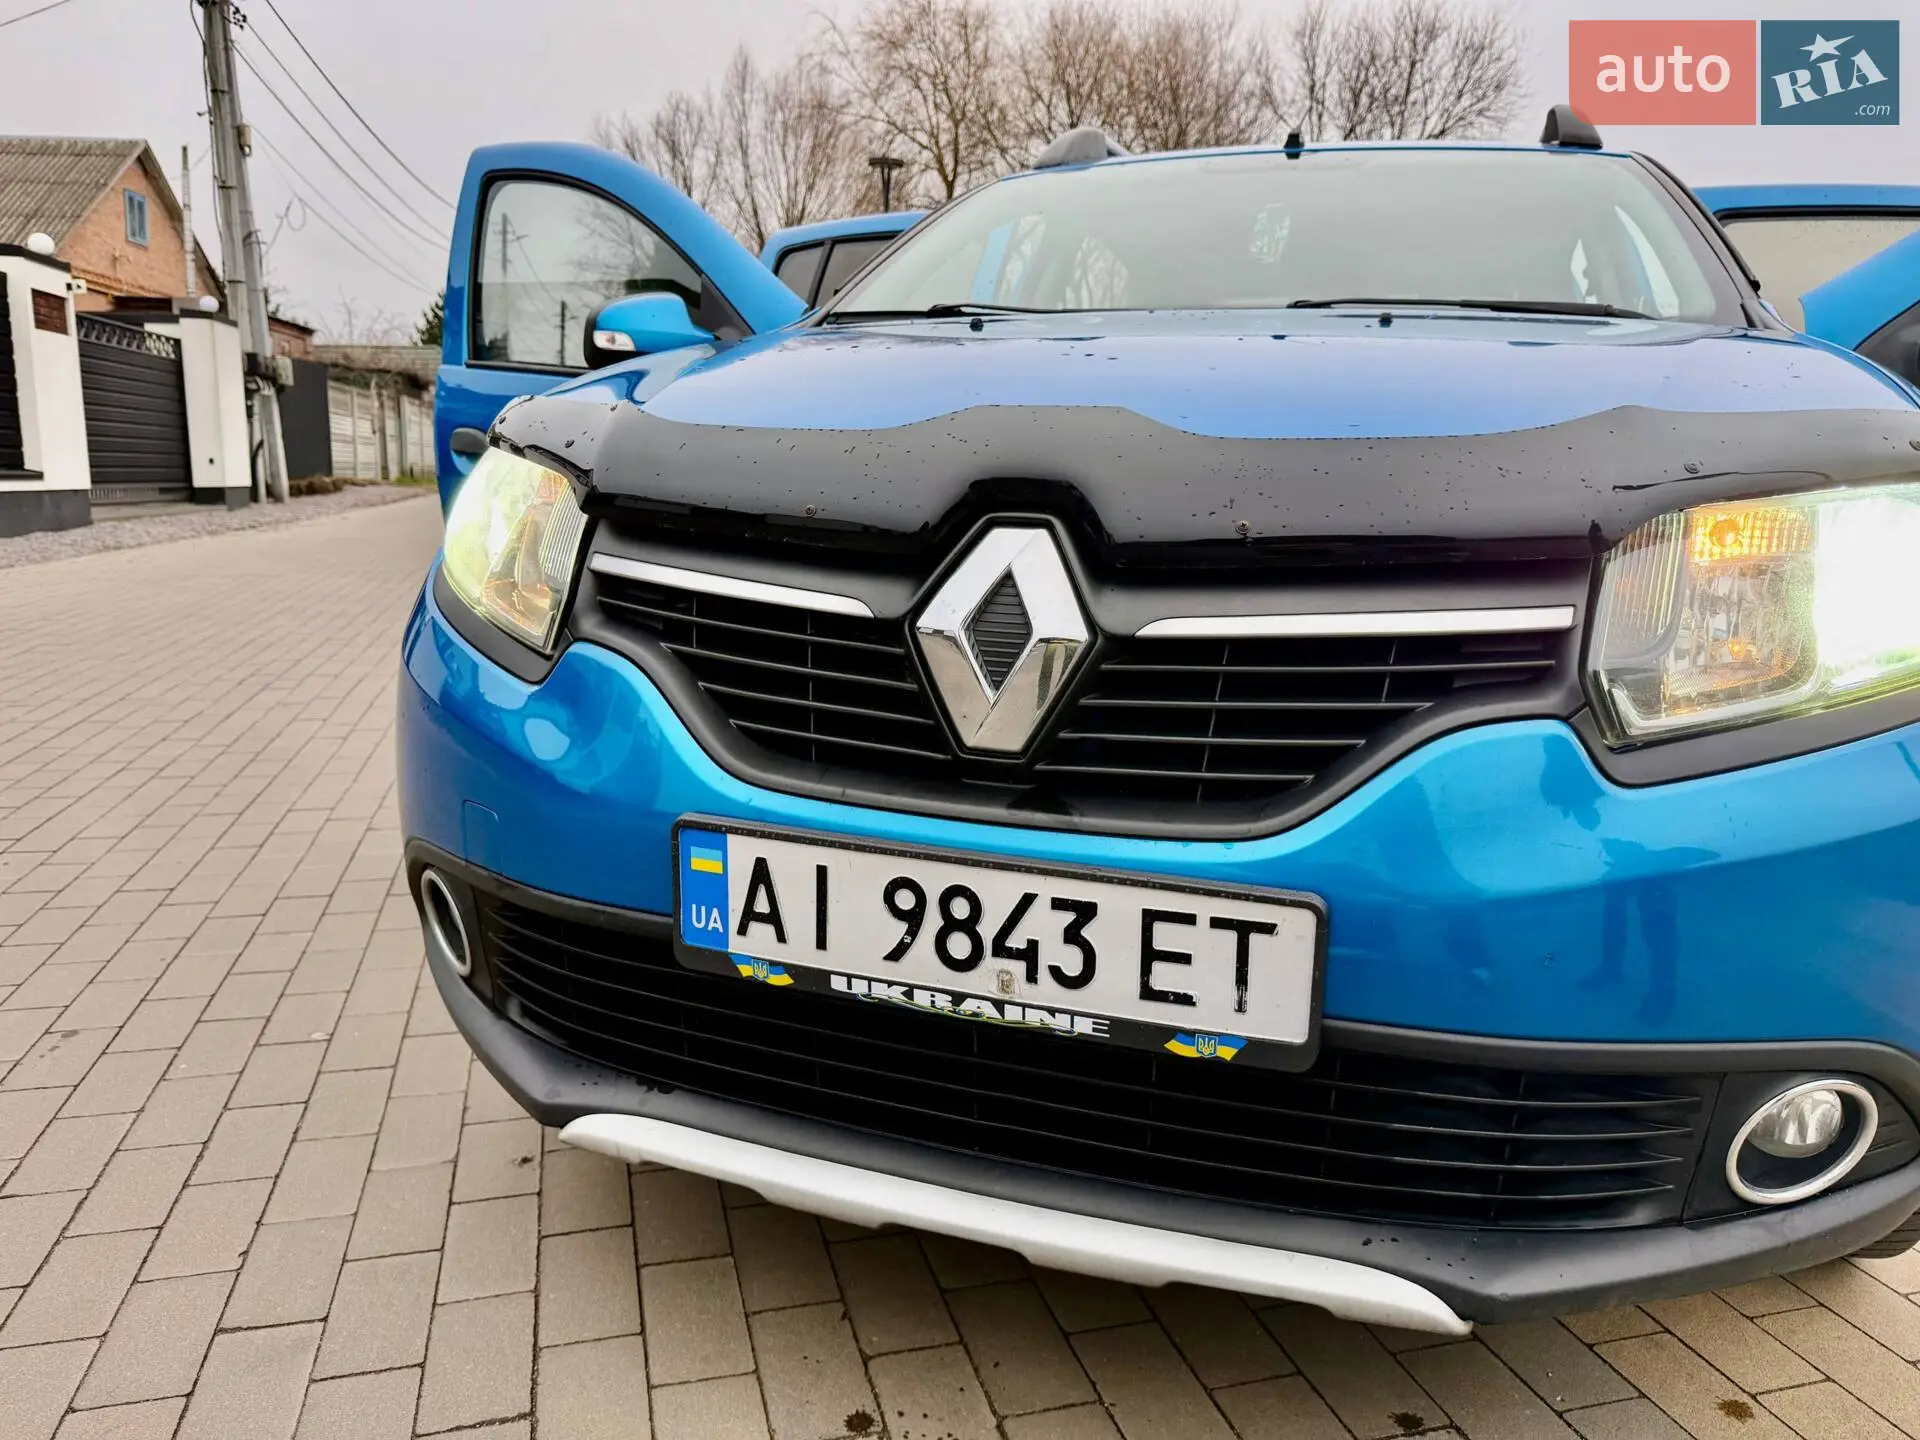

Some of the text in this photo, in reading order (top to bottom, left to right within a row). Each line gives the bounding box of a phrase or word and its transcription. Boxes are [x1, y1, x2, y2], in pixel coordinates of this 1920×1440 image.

[691, 903, 724, 933] UA
[736, 856, 1279, 1013] AI 9843 ET
[830, 974, 1110, 1037] UKRAINE
